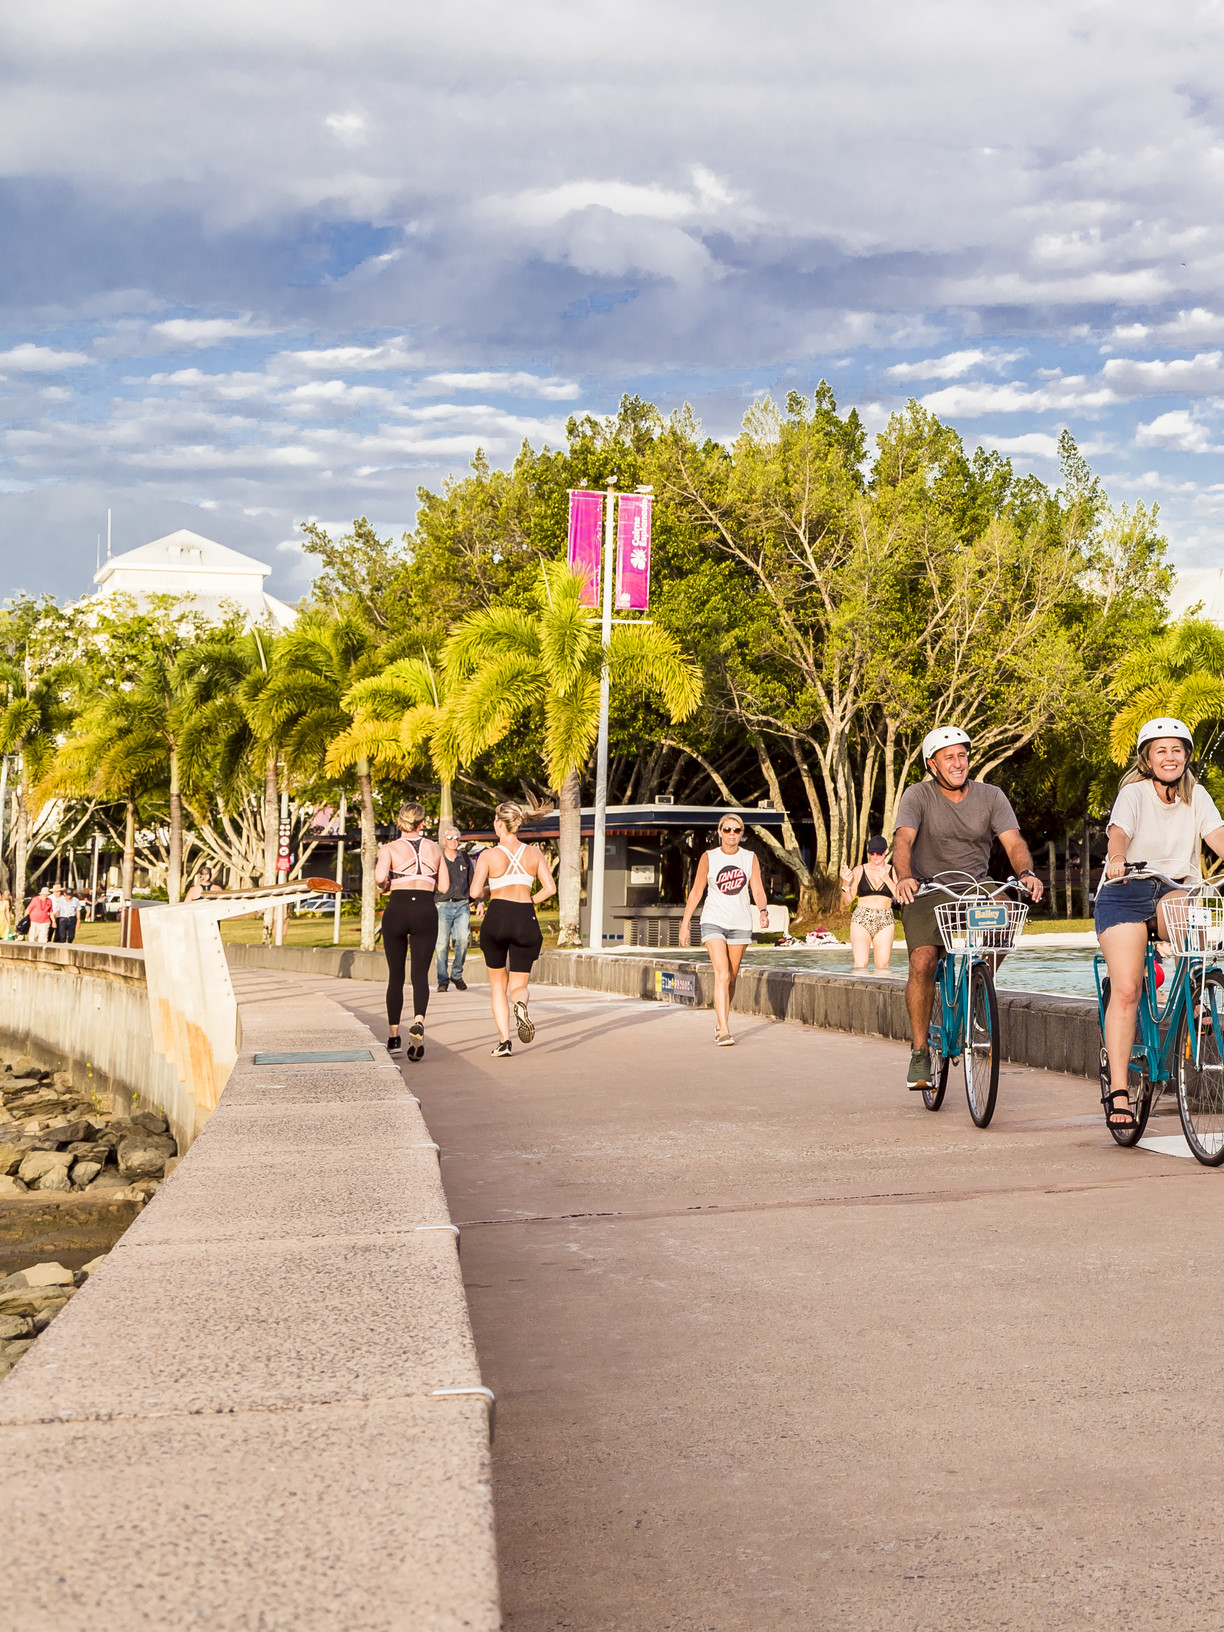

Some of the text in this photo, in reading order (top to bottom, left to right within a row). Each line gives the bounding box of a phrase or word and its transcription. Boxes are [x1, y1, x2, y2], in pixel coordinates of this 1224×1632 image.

[632, 516, 640, 546] Cairns
[639, 499, 649, 547] Esplanade
[715, 868, 745, 885] SANTA
[720, 877, 745, 893] CRUZ
[975, 910, 1000, 919] Bailey
